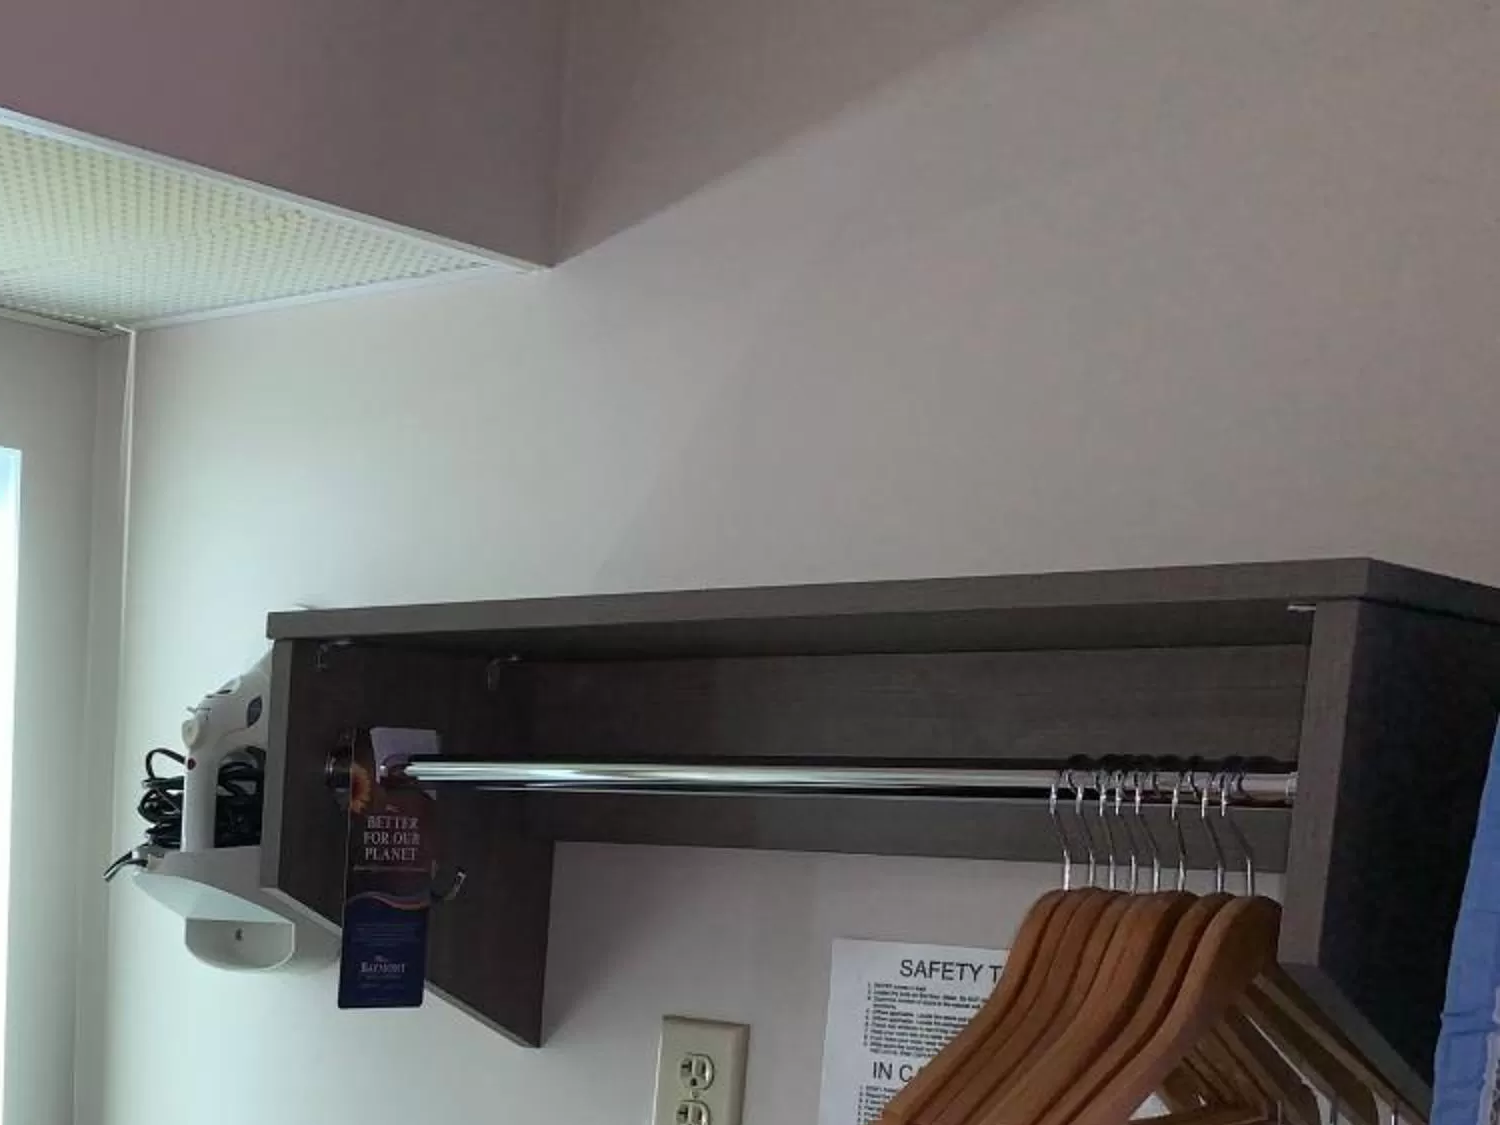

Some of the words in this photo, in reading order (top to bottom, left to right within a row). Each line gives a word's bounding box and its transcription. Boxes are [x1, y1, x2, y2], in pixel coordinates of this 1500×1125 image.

[367, 815, 419, 829] BETTER
[363, 831, 390, 845] FOR
[393, 831, 421, 845] OUR
[364, 847, 418, 861] PLANET
[899, 959, 983, 981] SAFETY
[873, 1062, 892, 1080] IN
